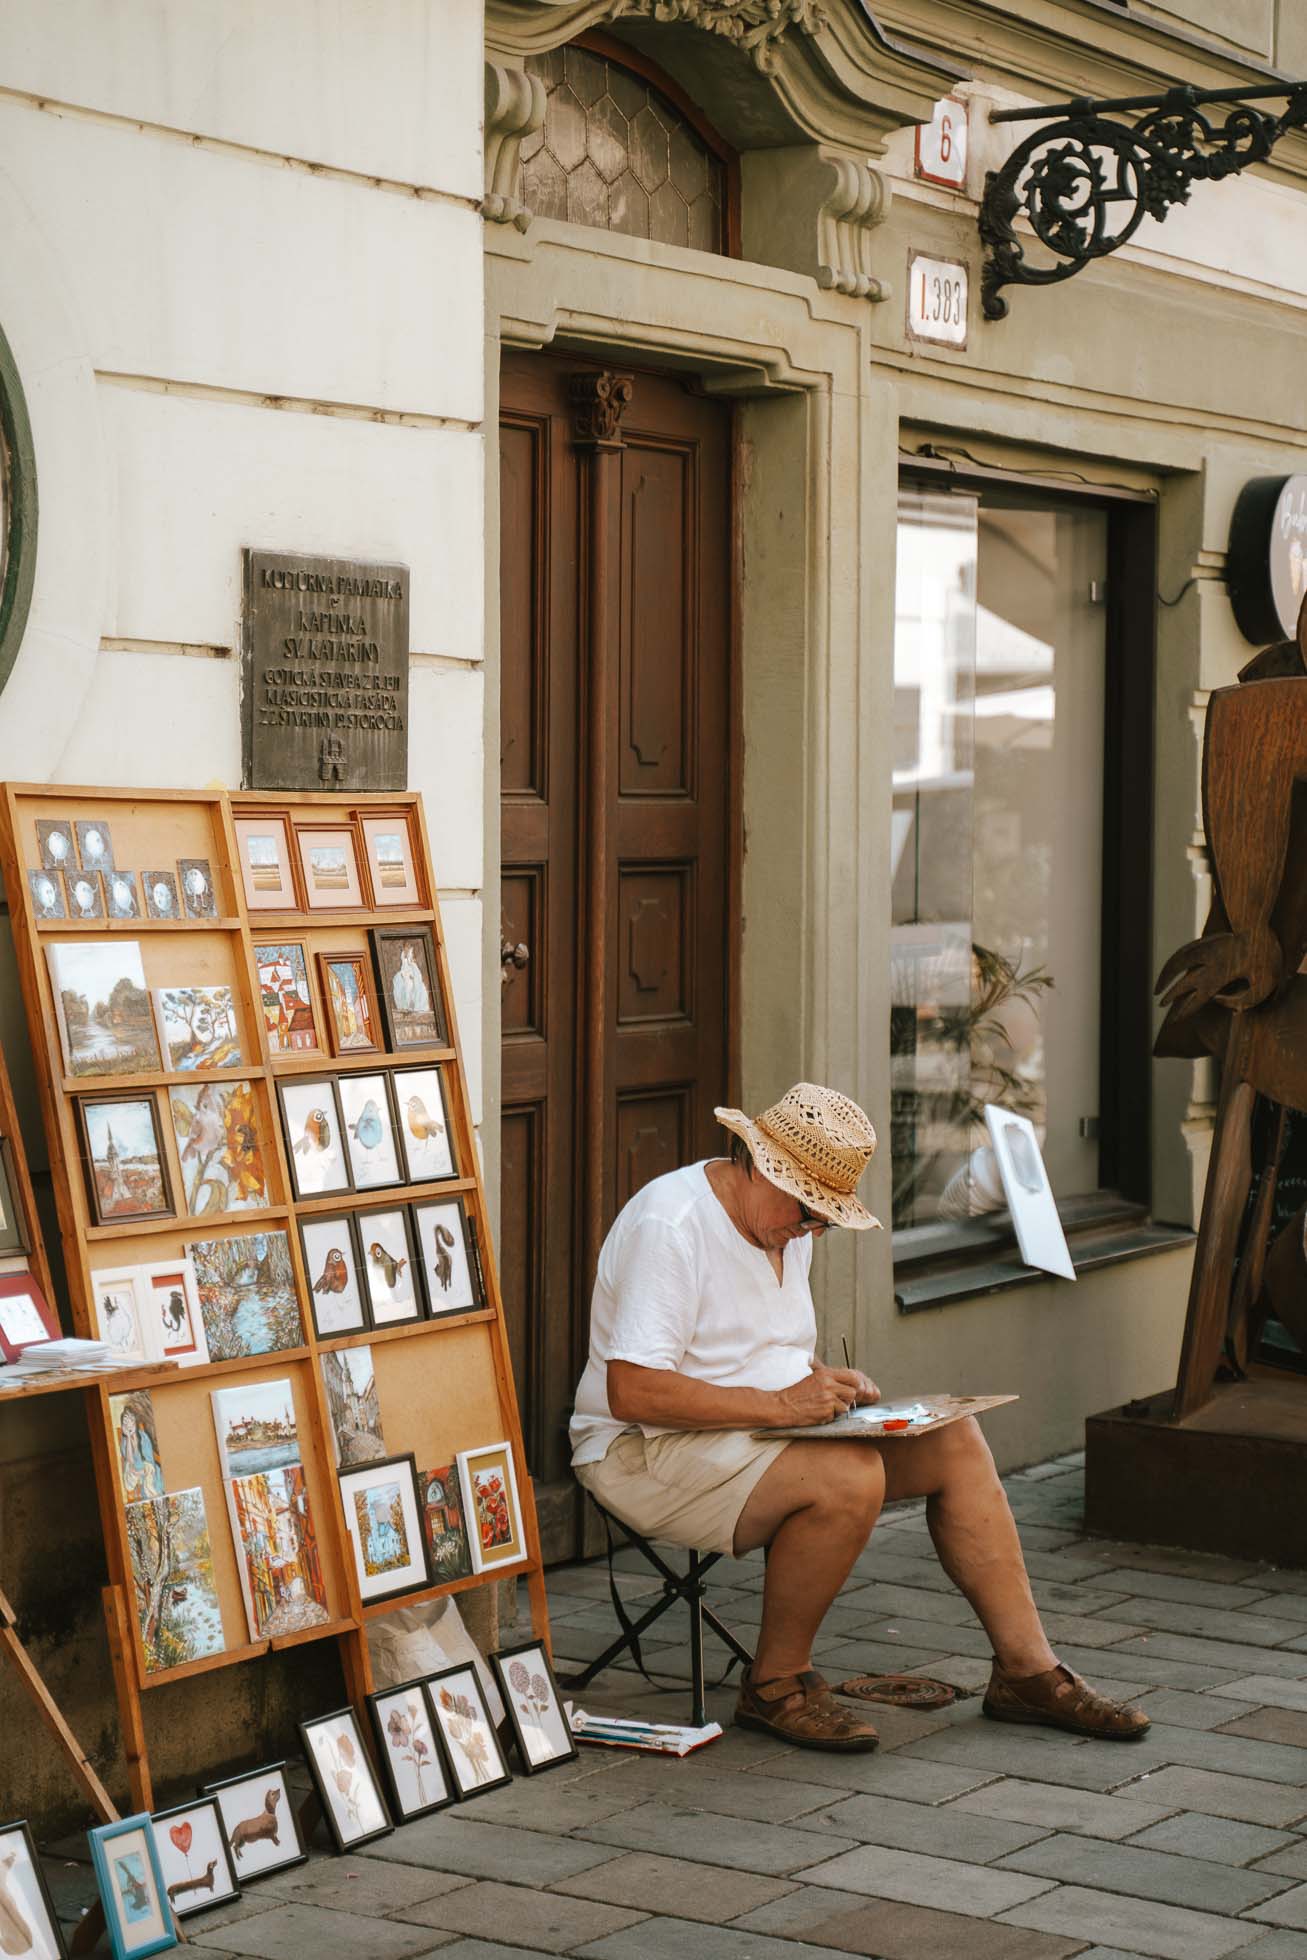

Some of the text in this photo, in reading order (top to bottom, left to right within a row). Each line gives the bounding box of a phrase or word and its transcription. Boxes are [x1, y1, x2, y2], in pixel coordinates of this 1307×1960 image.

[940, 114, 952, 163] 6
[261, 569, 403, 600] KULTÚRNA PAMIATKA
[298, 610, 367, 636] KAPLNKA
[283, 638, 379, 664] SV. KATARÍNY
[264, 668, 316, 687] GOTICKÁ
[320, 671, 361, 689] STAVBA
